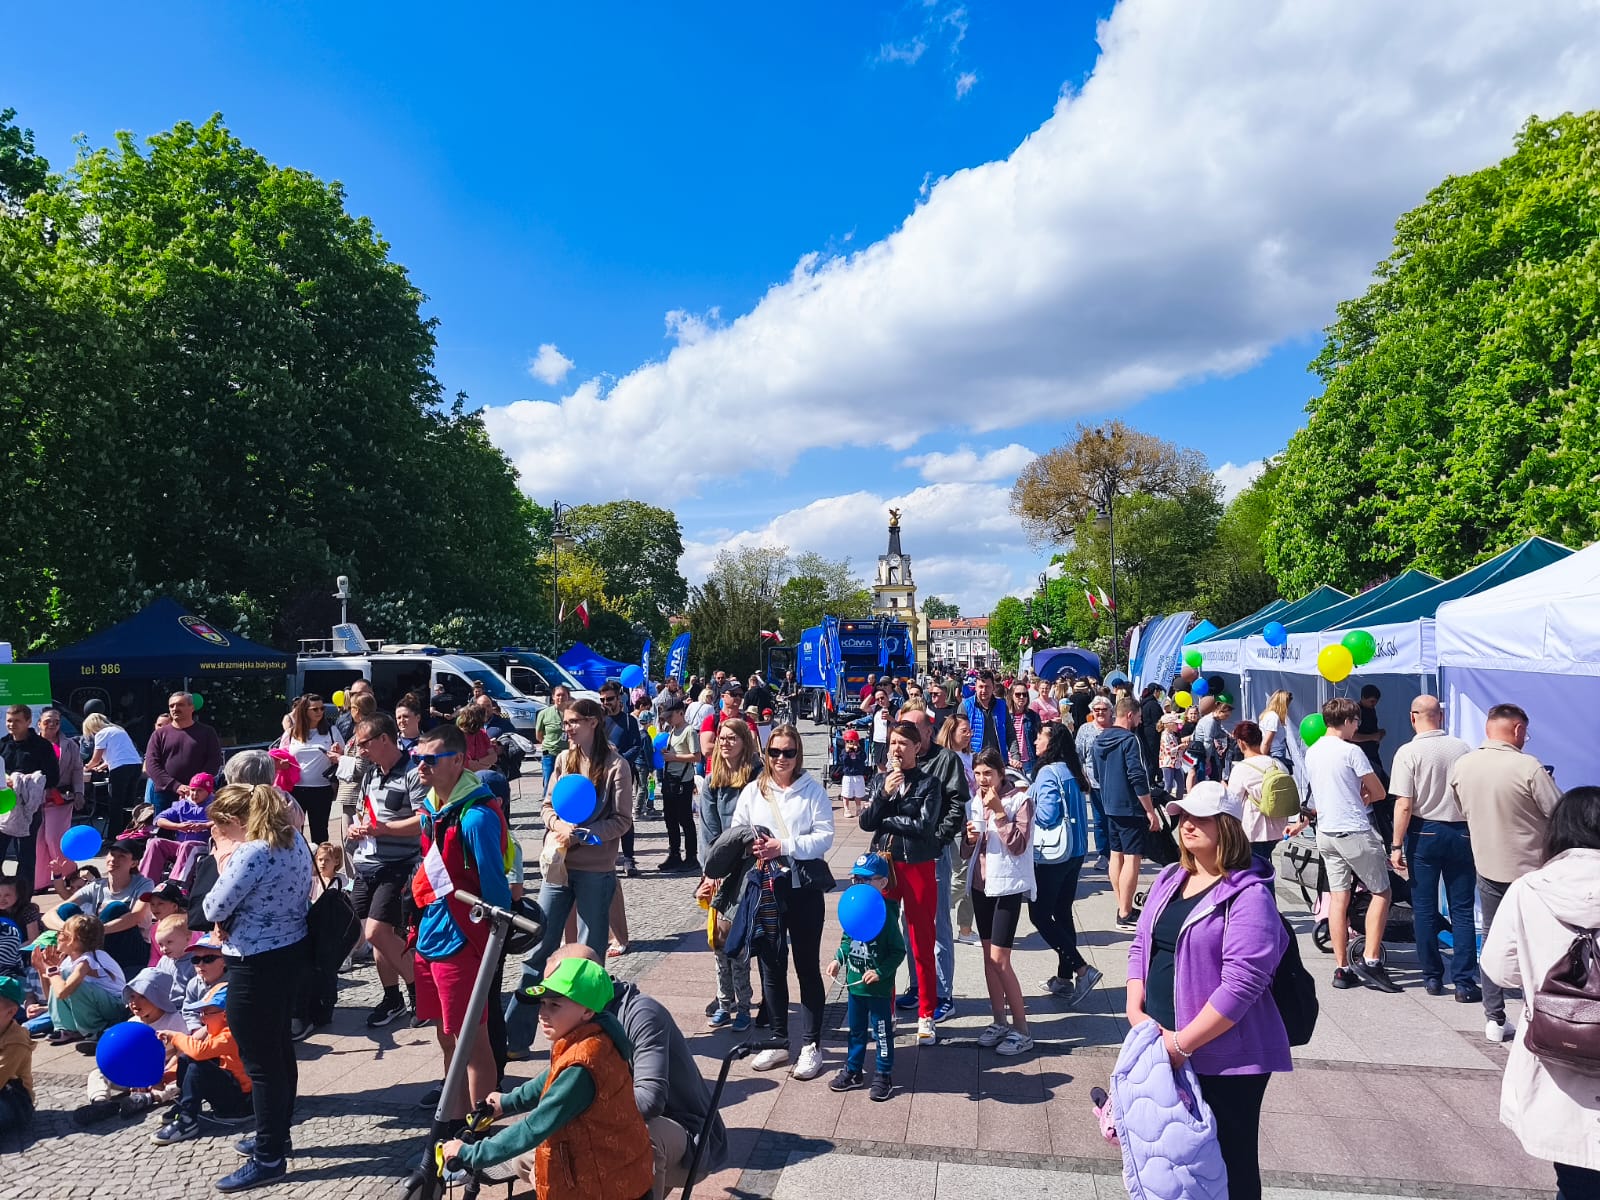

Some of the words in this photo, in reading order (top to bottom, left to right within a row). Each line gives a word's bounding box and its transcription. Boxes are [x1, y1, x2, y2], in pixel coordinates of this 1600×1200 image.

[841, 638, 873, 648] KOMA
[80, 664, 97, 675] tel.
[100, 663, 121, 674] 986
